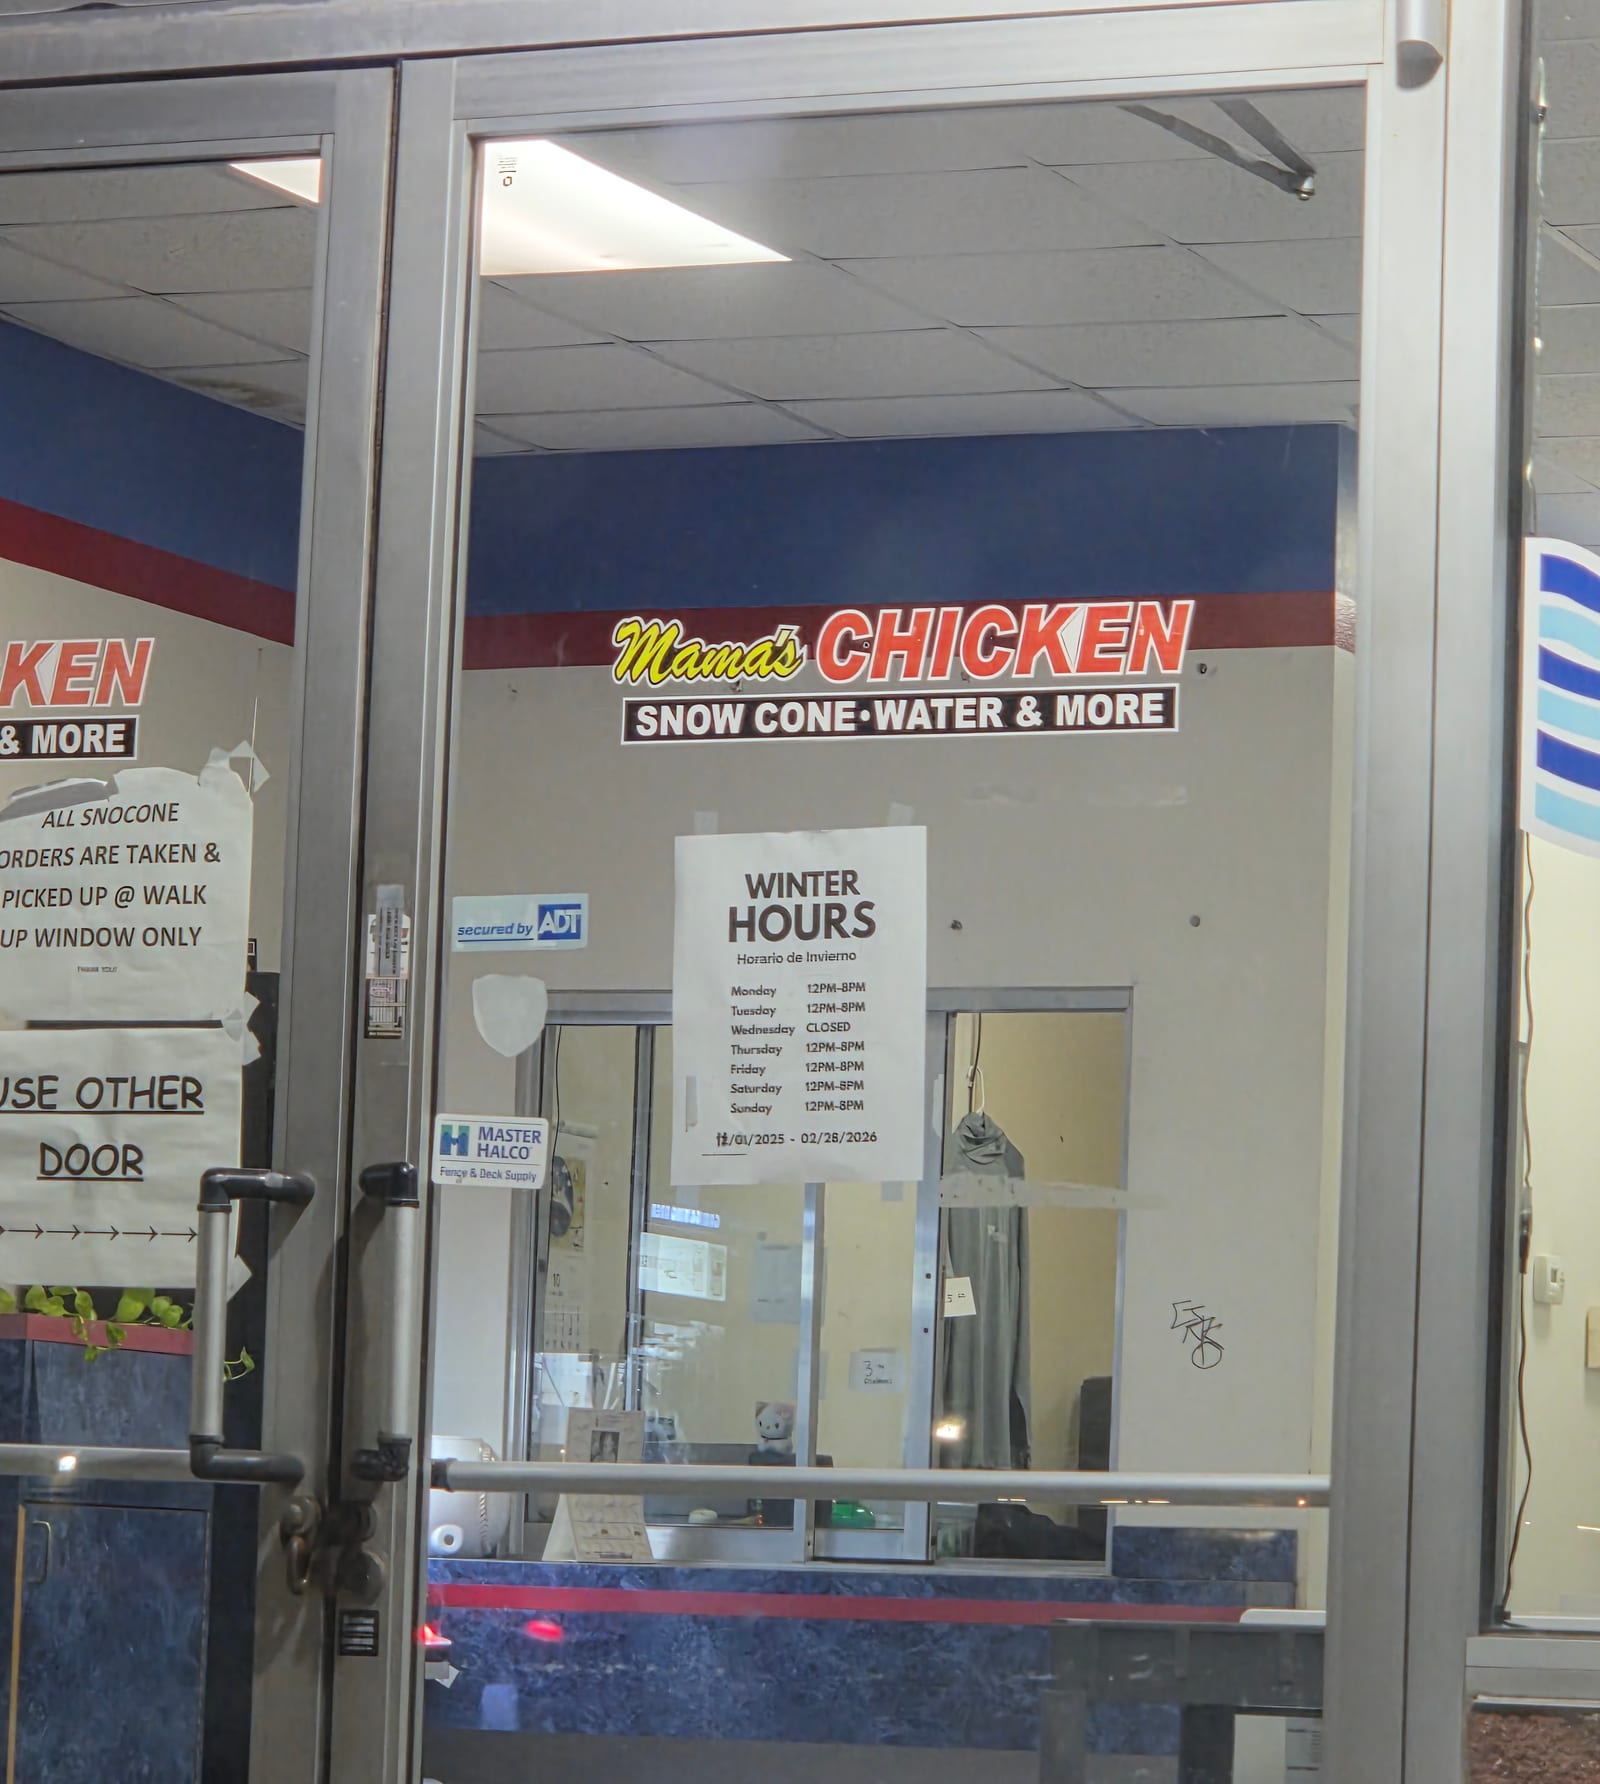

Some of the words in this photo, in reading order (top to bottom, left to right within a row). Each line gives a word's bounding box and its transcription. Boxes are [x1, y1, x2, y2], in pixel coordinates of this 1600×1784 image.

[614, 617, 806, 683] Mama's
[814, 600, 1194, 683] CHICKEN
[637, 703, 744, 737] SNOW
[1019, 699, 1042, 728] &
[1056, 693, 1164, 725] MORE
[0, 725, 20, 755] &
[31, 724, 125, 754] MORE
[42, 809, 75, 829] ALL
[81, 803, 179, 826] SNOCONE
[80, 846, 120, 866] ARE
[126, 843, 196, 865] TAKEN
[204, 842, 221, 863] &
[745, 869, 861, 899] WINTER
[2, 888, 73, 908] PICKED
[80, 887, 107, 907] UP
[114, 886, 135, 909] @
[143, 885, 207, 905] WALK
[457, 923, 514, 937] secured
[516, 922, 533, 938] by
[538, 909, 580, 934] ADT
[729, 901, 876, 943] HOURS
[0, 929, 28, 948] UP
[35, 927, 135, 948] WINDOW
[142, 926, 202, 947] ONLY
[737, 952, 783, 965] Horario
[787, 952, 803, 963] de
[806, 950, 857, 963] Invierno
[731, 985, 777, 998] Monday
[807, 982, 866, 993] 12PM-8PM
[731, 1005, 776, 1018] Tuesday
[807, 1002, 866, 1013] 12PM-8PM
[731, 1024, 796, 1037] Wednesday
[806, 1022, 851, 1033] CLOSED
[731, 1044, 783, 1056] Thursday
[806, 1041, 865, 1053] 12PM-8PM
[731, 1064, 766, 1077] Friday
[805, 1061, 864, 1073] 12PM-8PM
[76, 1075, 204, 1110] OTHER
[730, 1083, 783, 1096] Saturday
[805, 1080, 864, 1092] 12PM-8PM
[730, 1103, 773, 1116] Sunday
[805, 1100, 864, 1111] 12PM-8PM
[478, 1126, 542, 1145] MASTER
[801, 1131, 877, 1145] 02/28/2026
[40, 1142, 144, 1176] DOOR
[477, 1143, 530, 1160] HALCO
[440, 1166, 468, 1178] Fence
[470, 1168, 478, 1178] &
[480, 1168, 503, 1179] Deck
[505, 1170, 537, 1183] Supply
